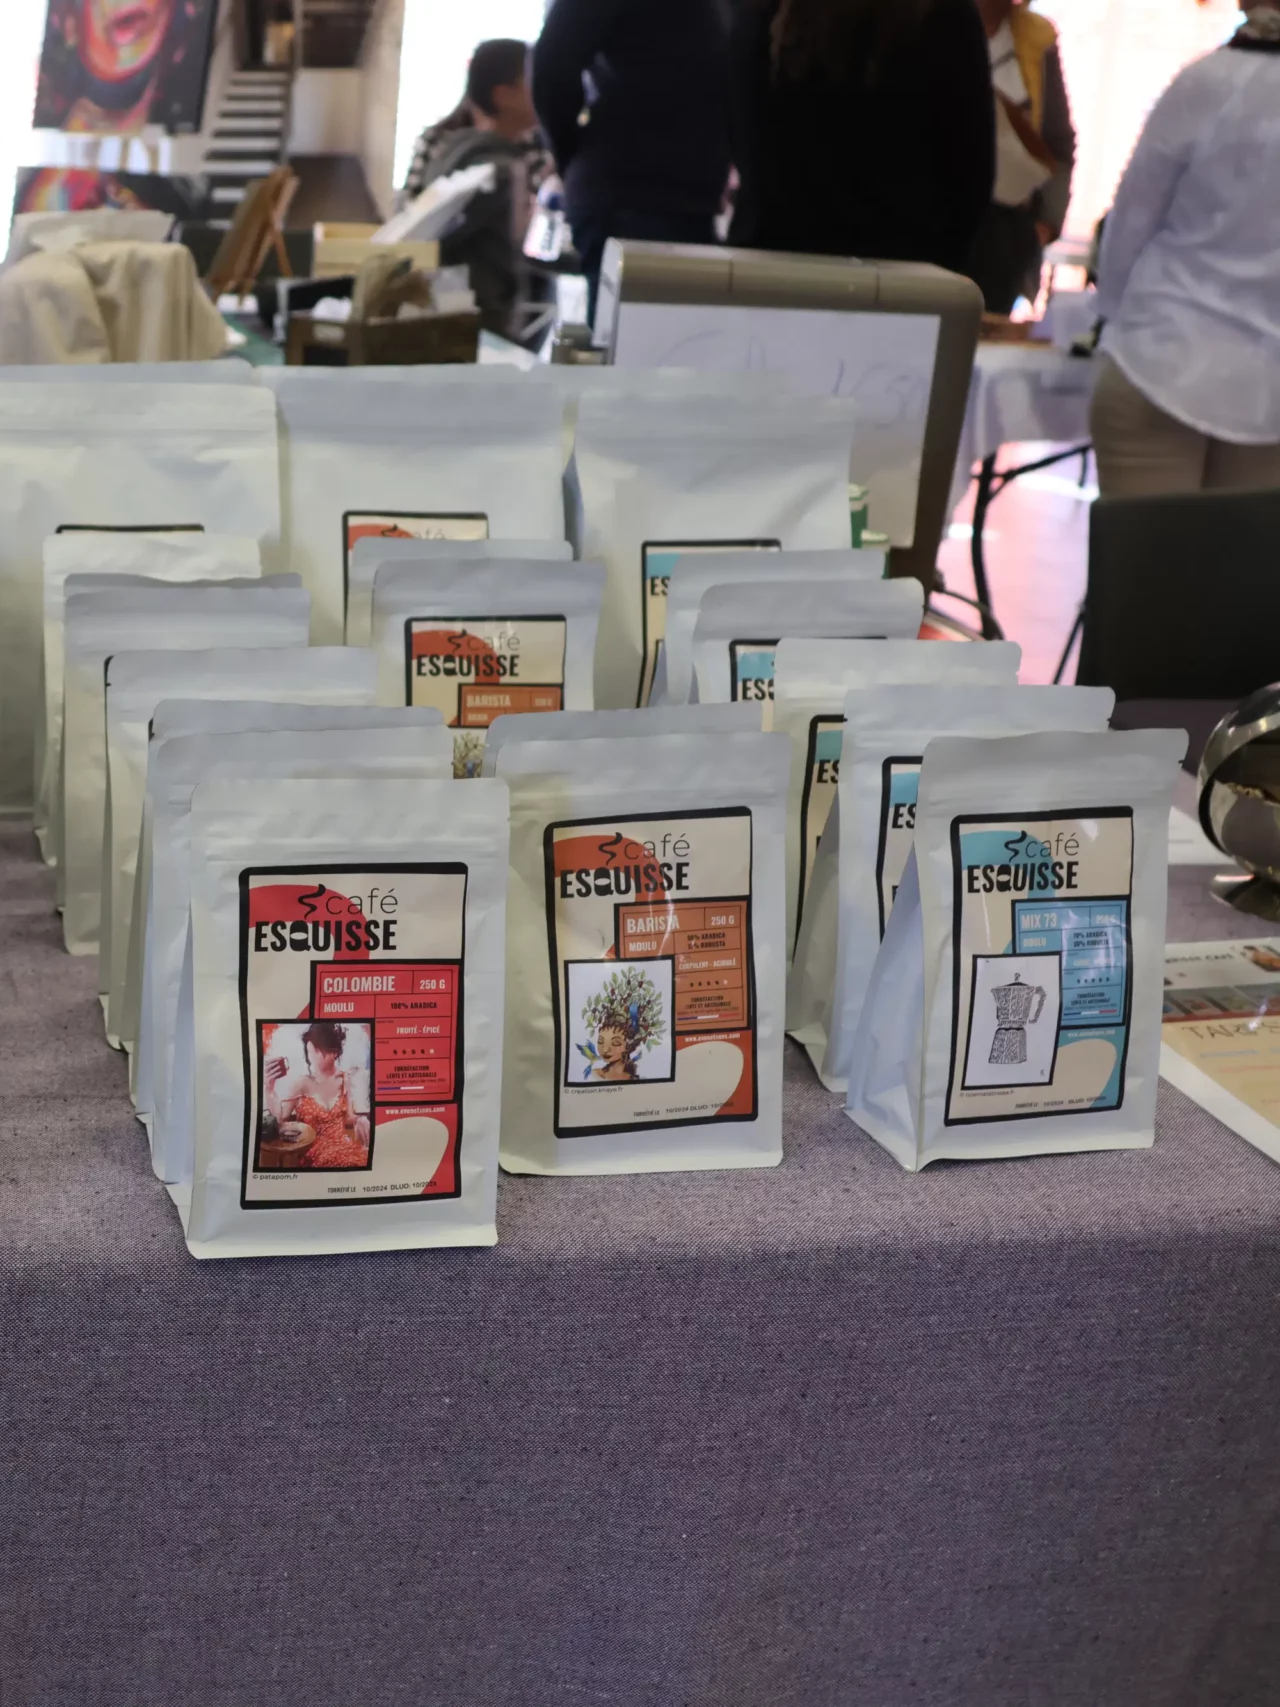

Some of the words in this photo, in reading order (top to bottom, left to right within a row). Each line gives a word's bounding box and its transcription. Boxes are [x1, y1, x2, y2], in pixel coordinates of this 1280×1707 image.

[467, 631, 520, 651] café
[416, 654, 519, 677] ESQUISSE
[624, 833, 690, 860] café
[1025, 832, 1079, 858] café
[560, 862, 690, 898] ESQUISSE
[967, 861, 1079, 894] ESQUISSE
[325, 888, 399, 915] café
[626, 915, 680, 934] BARISTA
[710, 916, 726, 926] 250
[728, 915, 735, 925] G
[1021, 914, 1042, 928] MIX
[1043, 913, 1057, 928] 73
[254, 920, 398, 952] ESQUISSE
[629, 941, 658, 952] MOULU
[323, 975, 396, 994] COLOMBIE
[420, 980, 437, 990] 250
[439, 979, 446, 989] G
[323, 1002, 355, 1013] MOULU
[396, 1025, 418, 1034] FRUITÉ
[422, 1025, 440, 1034] ÉPICÉ
[259, 1173, 299, 1181] patapom.fr
[362, 1185, 388, 1193] 10/2024
[390, 1183, 411, 1191] DLUO:
